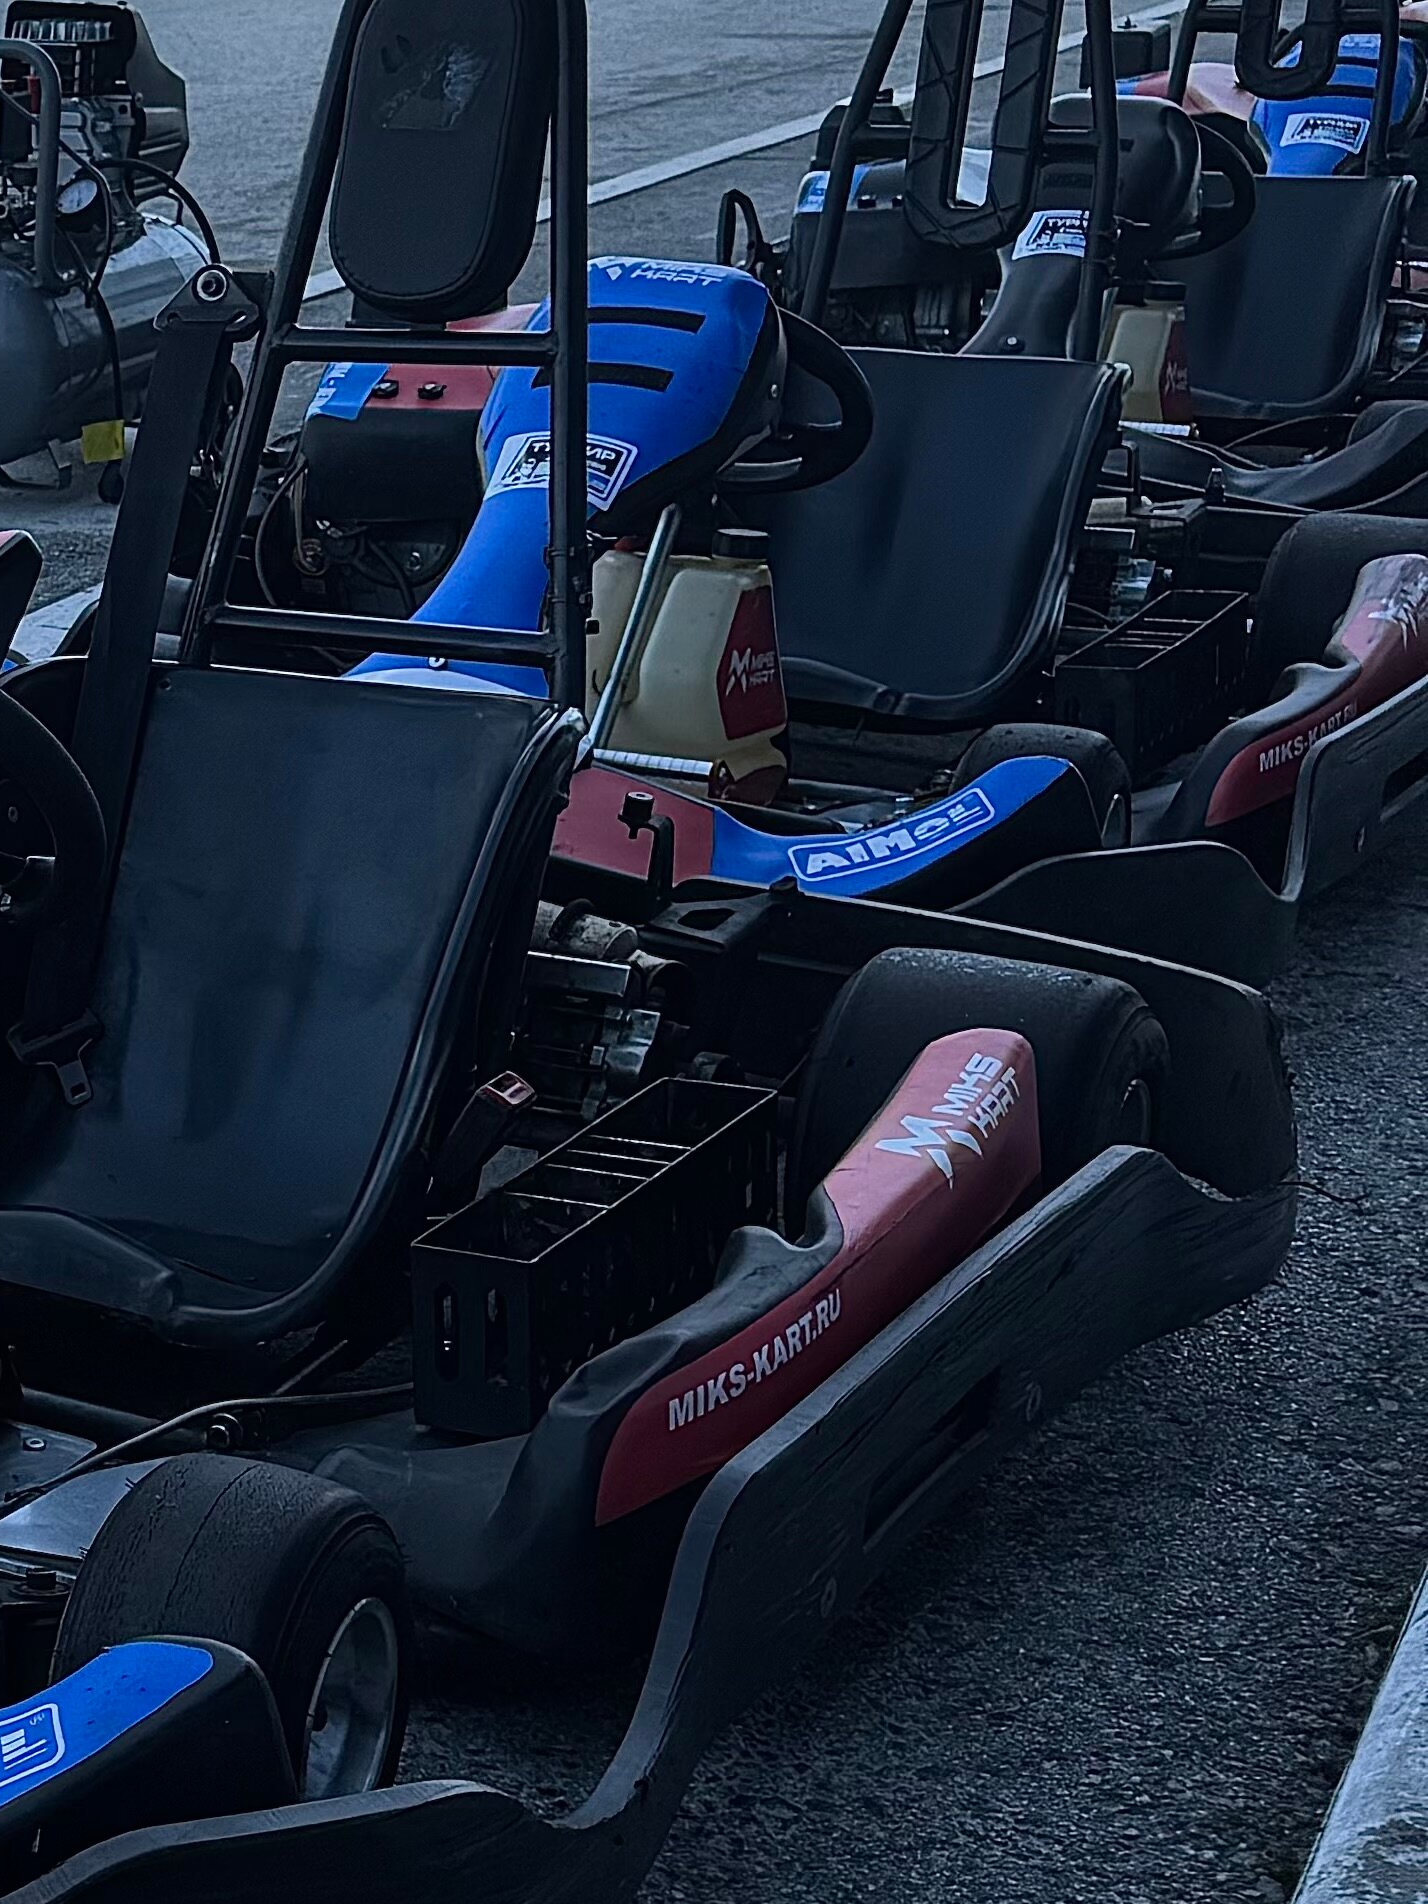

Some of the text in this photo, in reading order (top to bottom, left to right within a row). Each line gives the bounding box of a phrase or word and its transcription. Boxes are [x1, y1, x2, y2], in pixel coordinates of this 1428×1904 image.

[806, 803, 983, 875] AIMOL
[931, 1052, 1003, 1116] MIKS
[967, 1066, 1021, 1139] KART
[667, 1289, 843, 1432] MIKS-KART.RU
